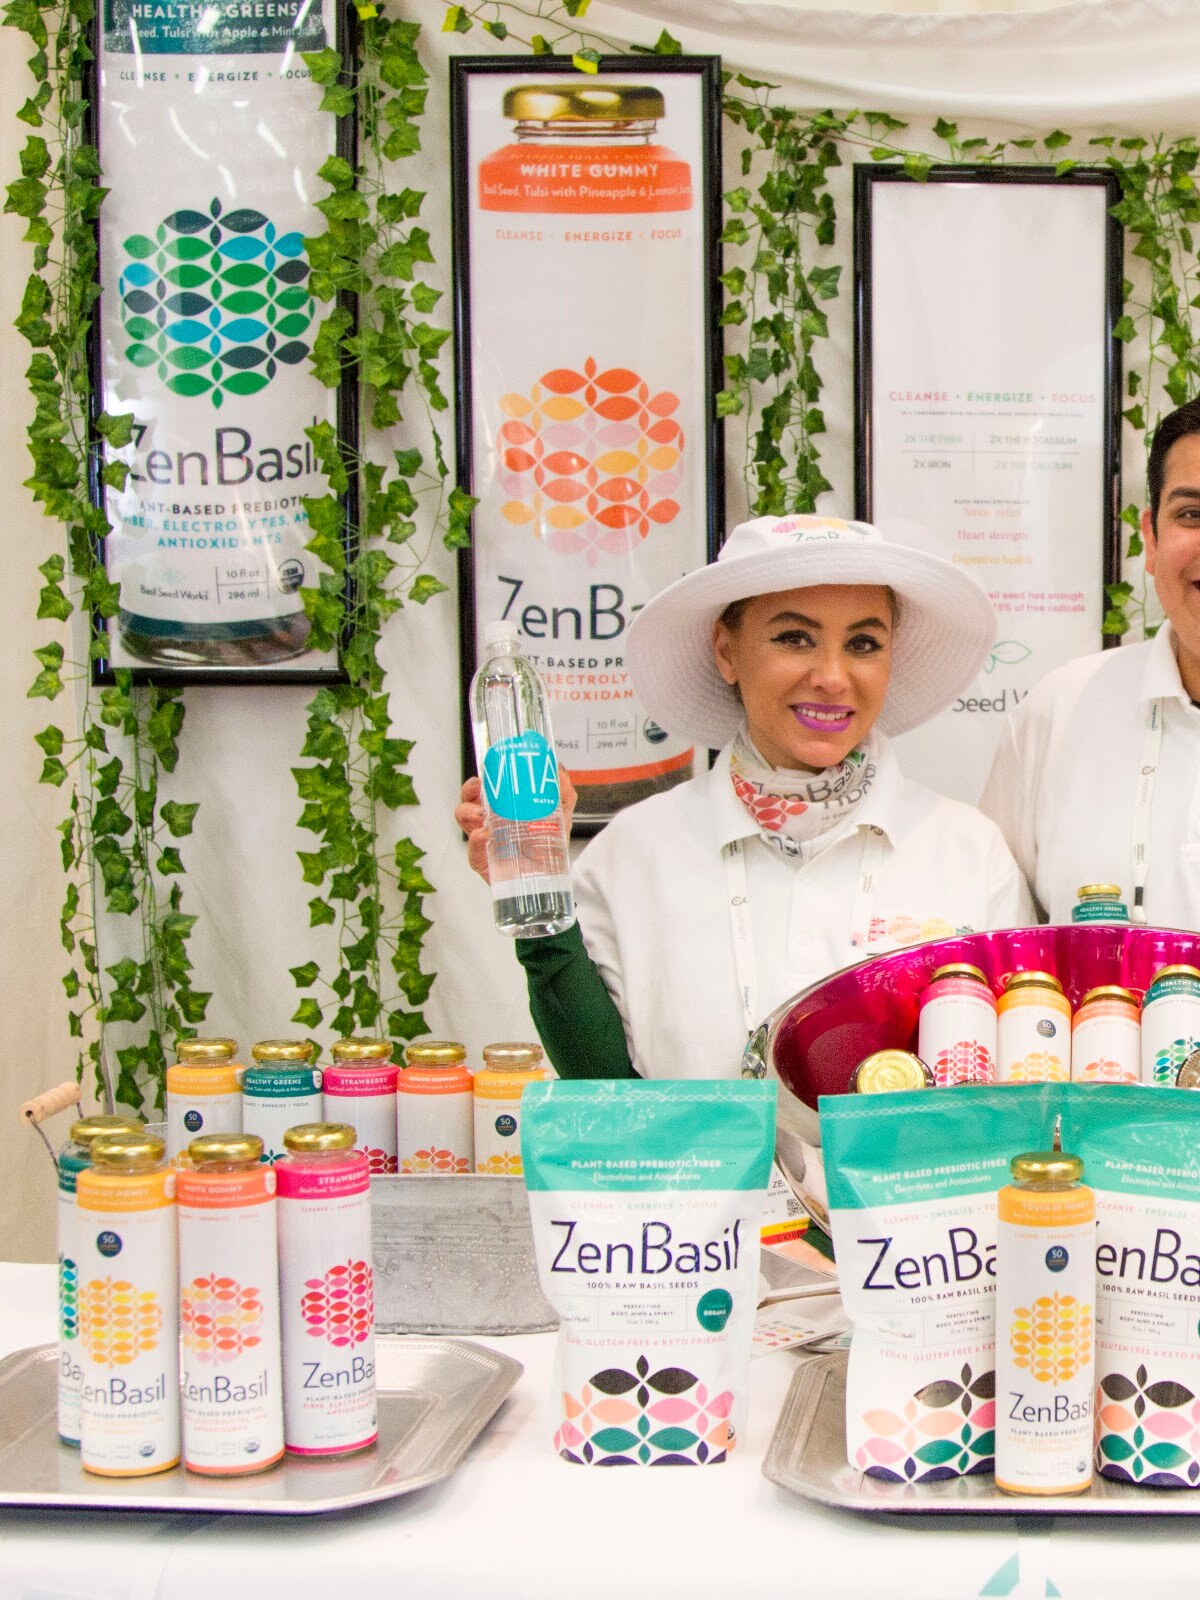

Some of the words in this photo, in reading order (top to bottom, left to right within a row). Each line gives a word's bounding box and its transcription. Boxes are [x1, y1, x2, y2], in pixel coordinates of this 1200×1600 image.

[226, 2, 298, 17] GREENS
[222, 28, 258, 40] Apple
[521, 163, 581, 178] WHITE
[589, 163, 659, 178] GUMMY
[524, 184, 549, 197] Tulsi
[552, 184, 576, 197] with
[579, 186, 636, 200] Pineapple
[640, 187, 646, 196] &
[496, 229, 543, 240] CLEANSE
[564, 231, 633, 241] ENERGIZE
[651, 229, 682, 240] FOCUS
[889, 391, 948, 402] CLEANSE
[967, 392, 1033, 403] ENERGIZE
[1052, 393, 1096, 403] FOCUS
[990, 435, 1003, 445] 2X
[913, 460, 926, 469] 2X
[928, 460, 951, 469] IRON
[958, 530, 984, 541] Heart
[988, 530, 1028, 542] strength
[1003, 592, 1025, 600] seed
[1048, 592, 1084, 601] enough
[1015, 604, 1024, 612] of
[596, 740, 614, 749] 296
[484, 752, 559, 800] VITA
[1160, 980, 1192, 988] HEALTHY
[341, 1077, 387, 1085] STRAWBERRY
[572, 1160, 637, 1169] PLANT-BASED
[639, 1160, 692, 1169] PREBIOTIC
[1105, 1160, 1164, 1175] PLANT-BASED
[593, 1172, 637, 1181] Electrolytes
[638, 1173, 652, 1181] and
[872, 1169, 932, 1184] PLANT-BASED
[934, 1162, 981, 1176] PREBIOTIC
[982, 1158, 1007, 1170] FIBER
[949, 1174, 991, 1188] Antioxidants
[1097, 1201, 1134, 1213] CLEANSE
[931, 1207, 973, 1220] ENERGIZE
[102, 1234, 116, 1244] 50
[549, 1218, 742, 1275] ZenBasil
[1052, 1249, 1062, 1258] 50
[669, 1281, 699, 1289] SEEDS
[911, 1296, 934, 1305] 100%
[936, 1291, 954, 1300] RAW
[957, 1288, 981, 1297] BASIL
[1102, 1284, 1123, 1293] 100%
[1126, 1287, 1144, 1295] RAW
[1147, 1289, 1170, 1300] BASIL
[703, 1309, 727, 1317] ORGANIC
[587, 1338, 624, 1346] GLUTEN
[627, 1338, 650, 1347] FREE
[662, 1338, 688, 1346] KETO
[913, 1351, 950, 1362] GLUTEN
[952, 1348, 972, 1358] FREE
[1100, 1340, 1129, 1352] GLUTEN
[1130, 1346, 1152, 1356] FREE
[1162, 1350, 1187, 1361] KETO
